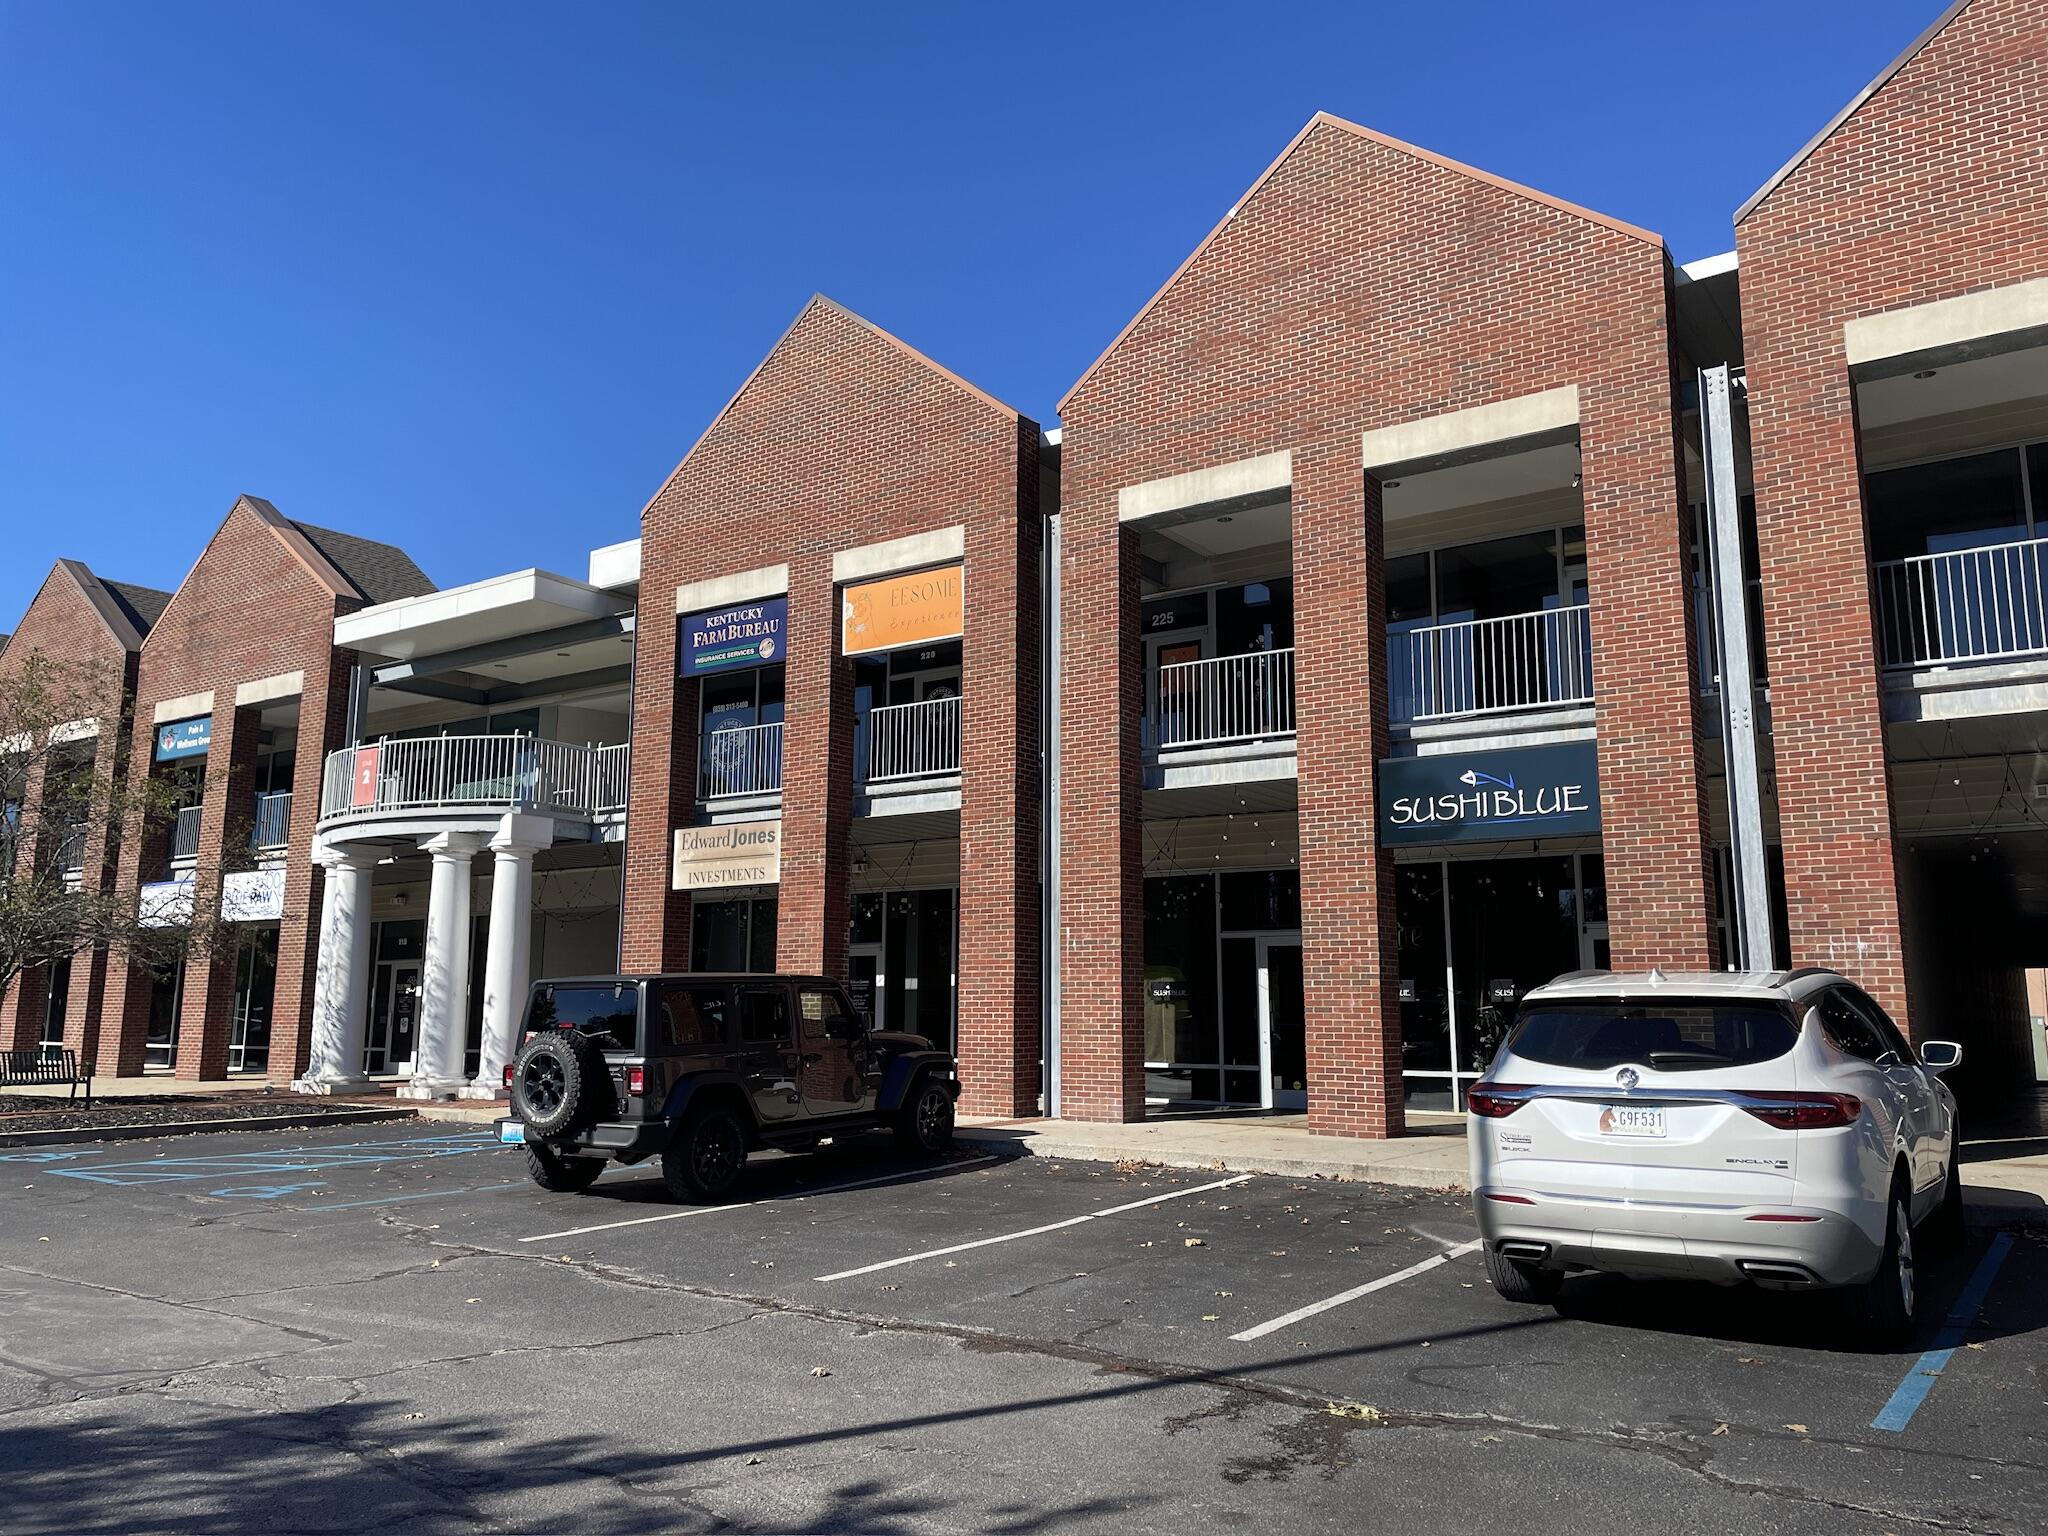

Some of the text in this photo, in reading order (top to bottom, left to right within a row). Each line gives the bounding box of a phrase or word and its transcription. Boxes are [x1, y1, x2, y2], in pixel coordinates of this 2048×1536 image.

[706, 607, 764, 628] KENTUCKY
[1151, 611, 1174, 627] 225
[694, 648, 755, 664] INSURANCE SERVICES
[362, 769, 370, 785] 2
[681, 828, 776, 851] Edward Jones
[688, 866, 765, 885] INVESTMENTS
[1619, 1111, 1663, 1127] G9F531
